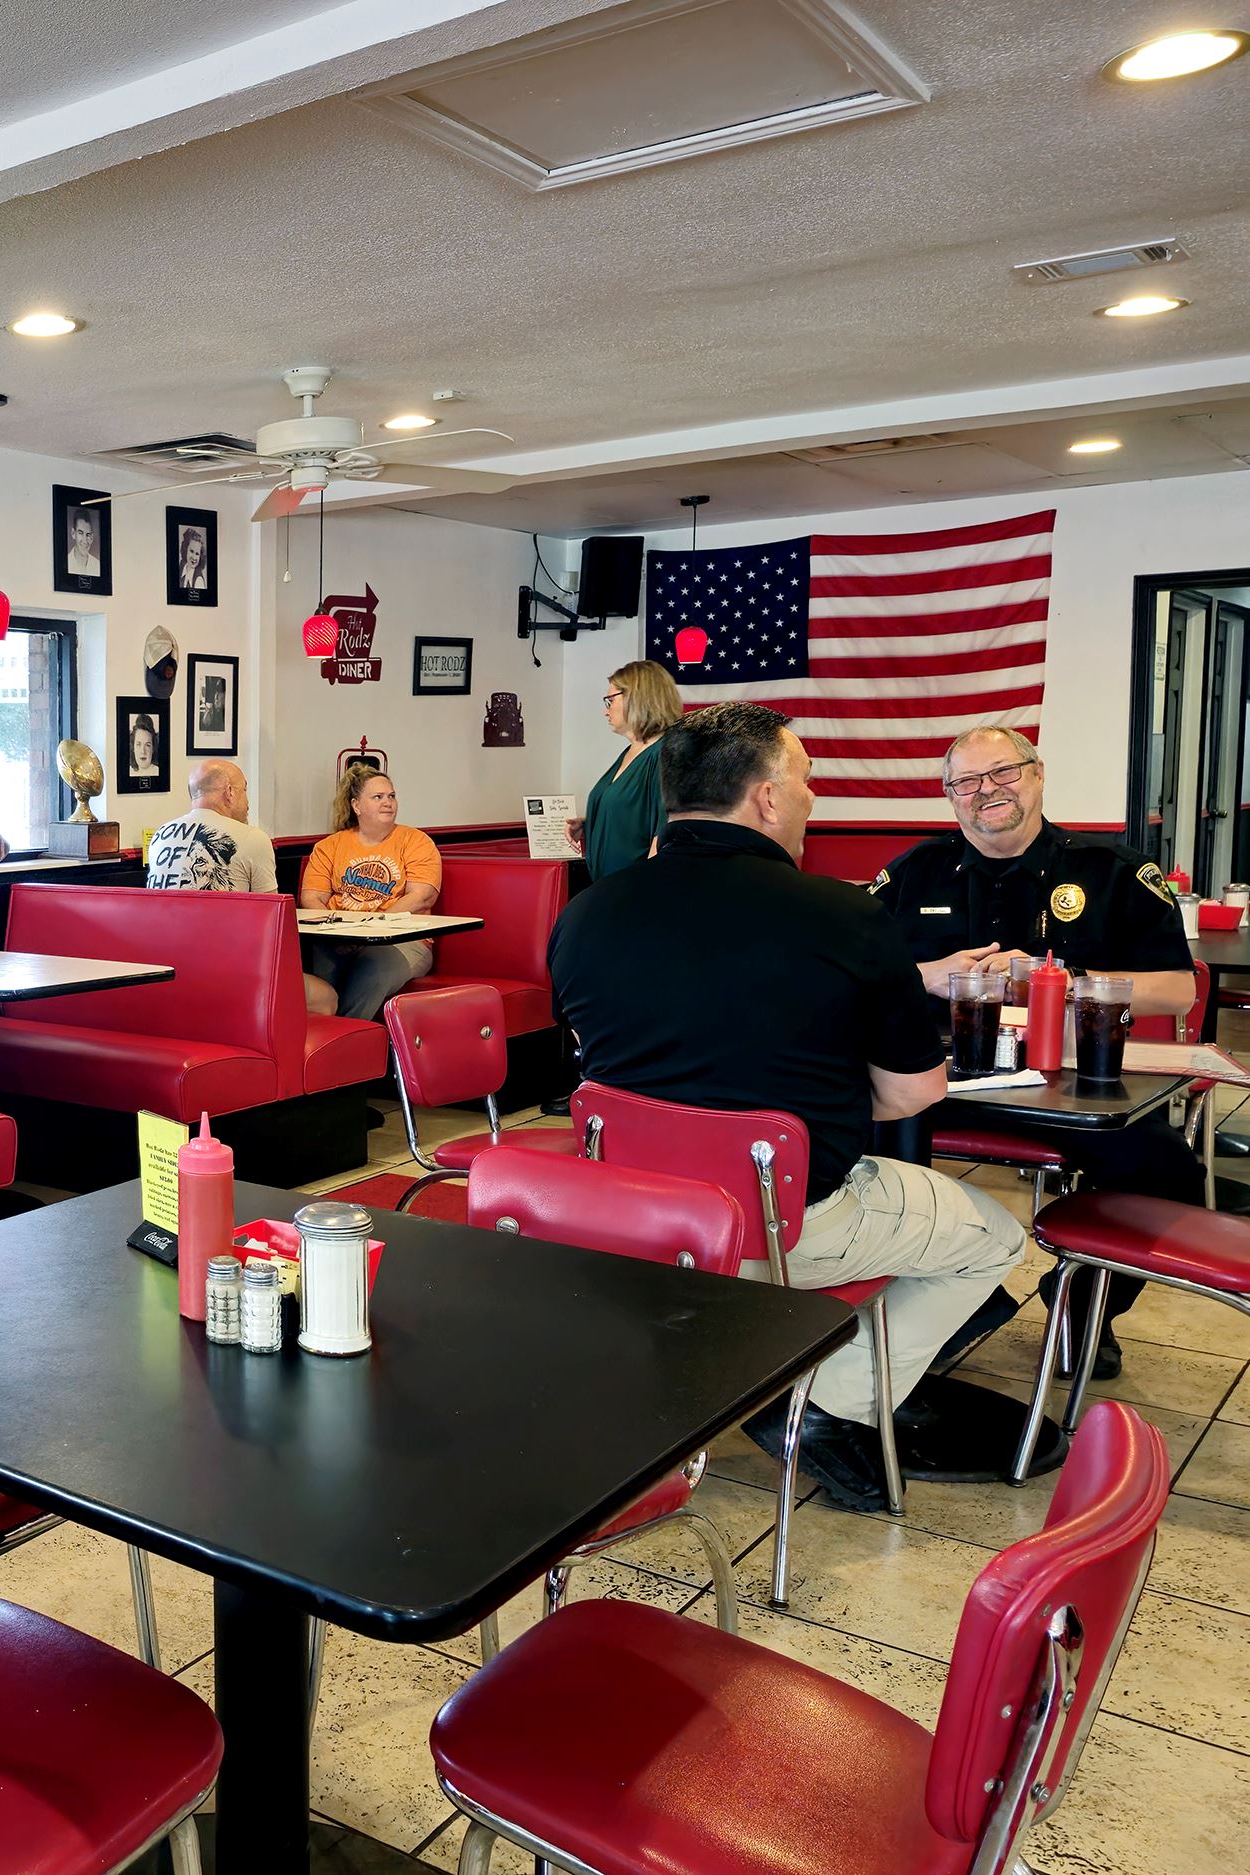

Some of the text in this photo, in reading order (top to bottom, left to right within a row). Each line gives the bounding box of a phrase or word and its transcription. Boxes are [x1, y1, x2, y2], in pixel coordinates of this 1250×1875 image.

[336, 627, 371, 657] Rodz
[338, 661, 372, 678] DINER
[420, 655, 466, 671] HOT RODZ
[155, 846, 187, 869] OF
[383, 856, 401, 880] GUMP
[341, 866, 396, 896] Normal
